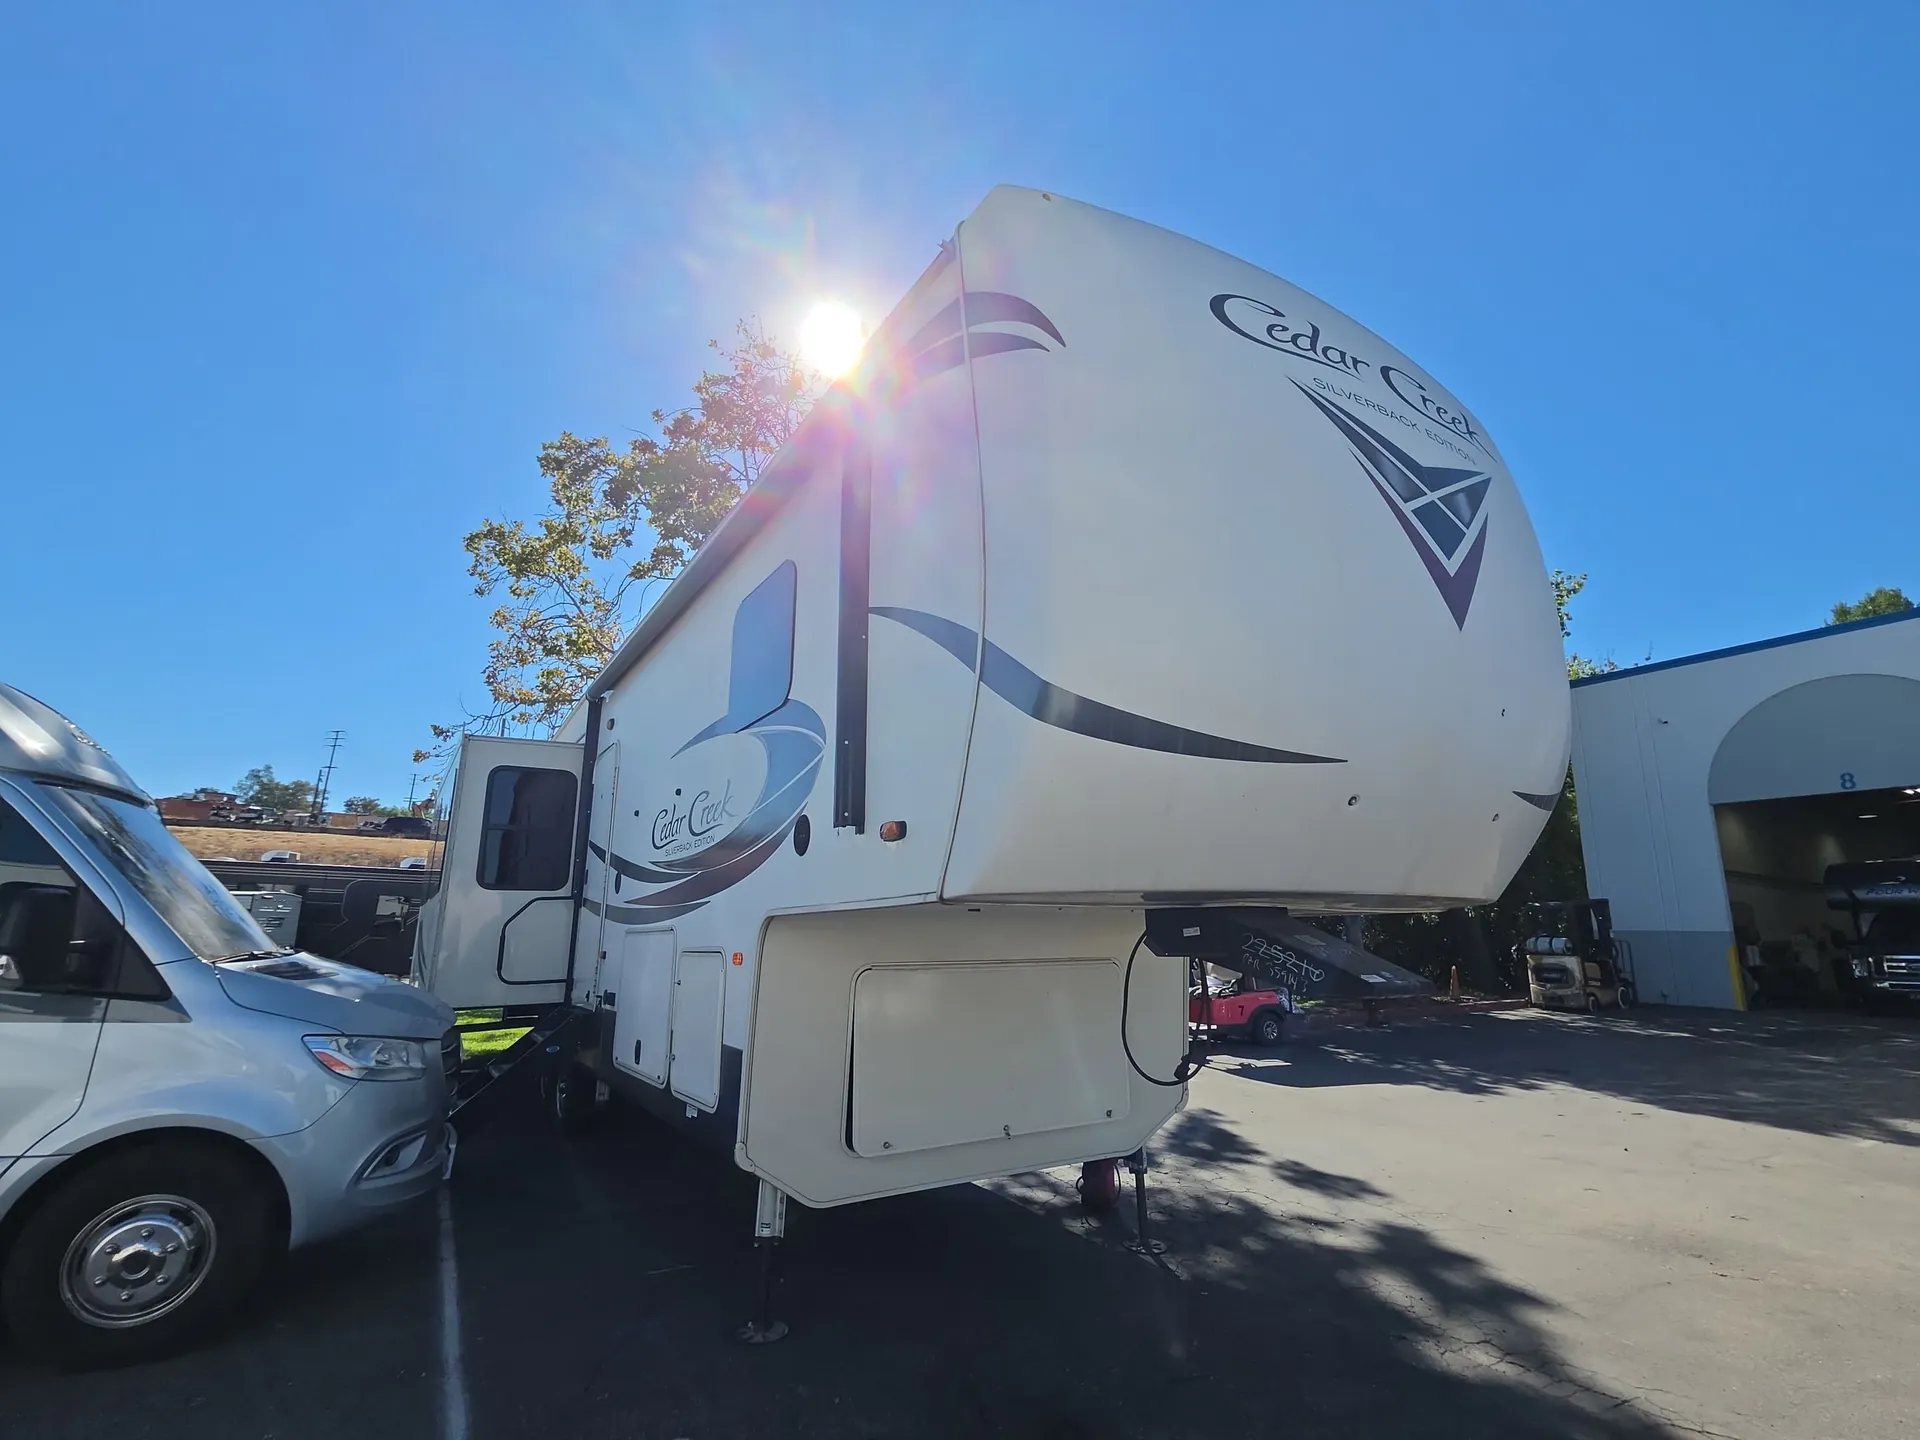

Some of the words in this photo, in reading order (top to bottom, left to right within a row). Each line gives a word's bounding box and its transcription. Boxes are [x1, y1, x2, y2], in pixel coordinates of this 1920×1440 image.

[1209, 293, 1370, 382] Cedar
[1379, 365, 1498, 463] Creek
[1312, 377, 1422, 433] SILVERBACK
[1426, 430, 1477, 466] EDITION
[1840, 772, 1856, 790] 8
[652, 803, 686, 850] Cedar
[688, 778, 738, 837] Creek
[664, 843, 693, 857] SILVERBACK
[694, 834, 715, 848] EDITION
[1238, 1005, 1245, 1016] 7
